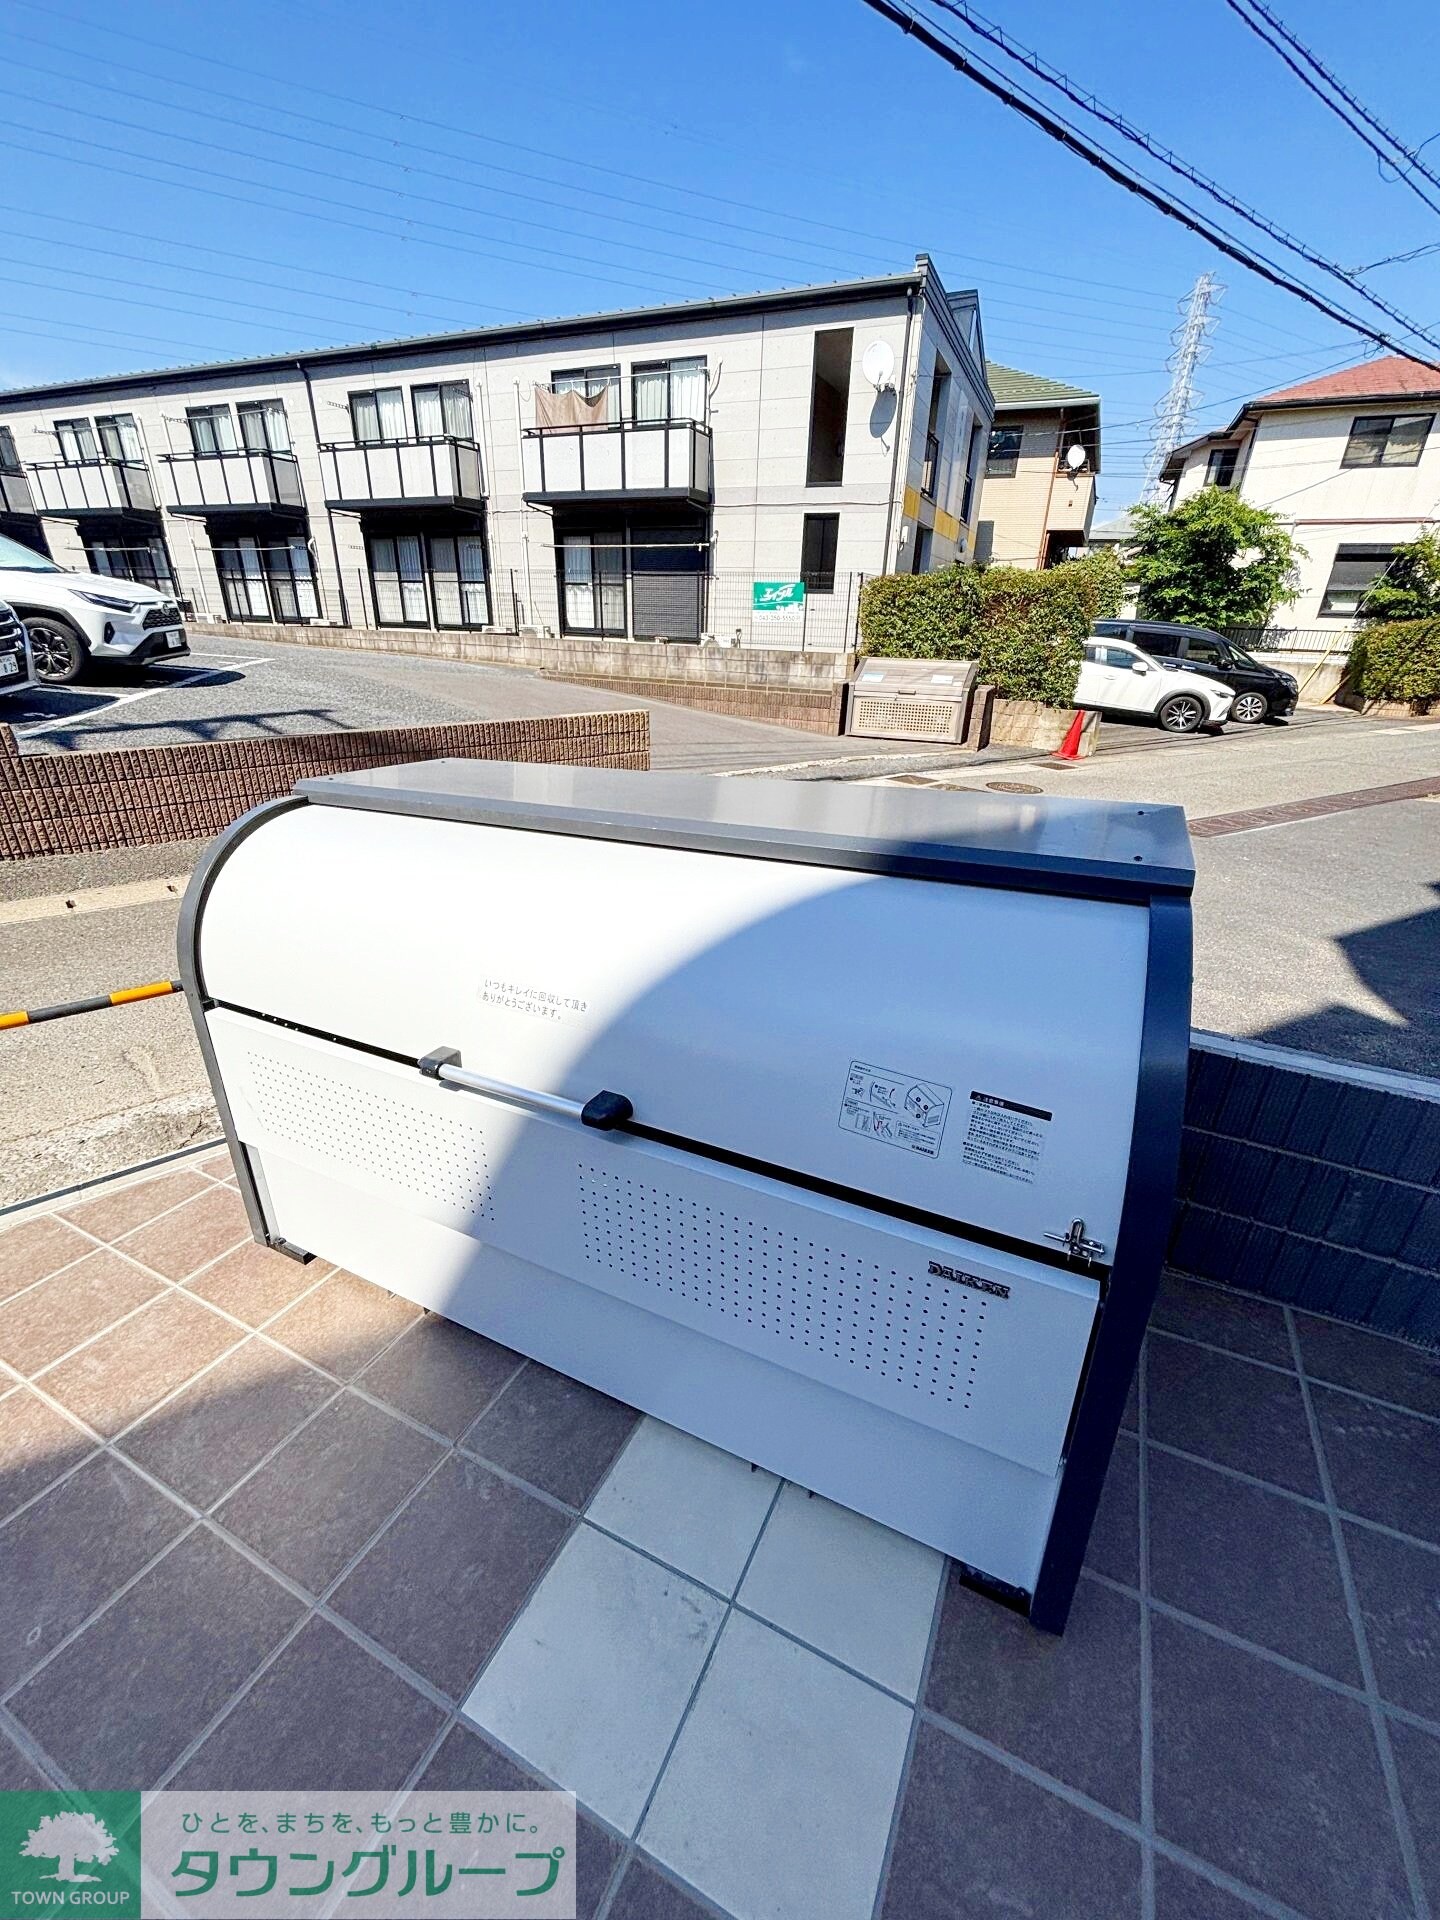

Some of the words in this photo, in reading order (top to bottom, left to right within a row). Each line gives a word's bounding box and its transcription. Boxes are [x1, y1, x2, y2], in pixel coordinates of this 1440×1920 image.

[482, 991, 561, 1020] ありがとうございます。
[927, 1260, 1011, 1299] DAIKEN
